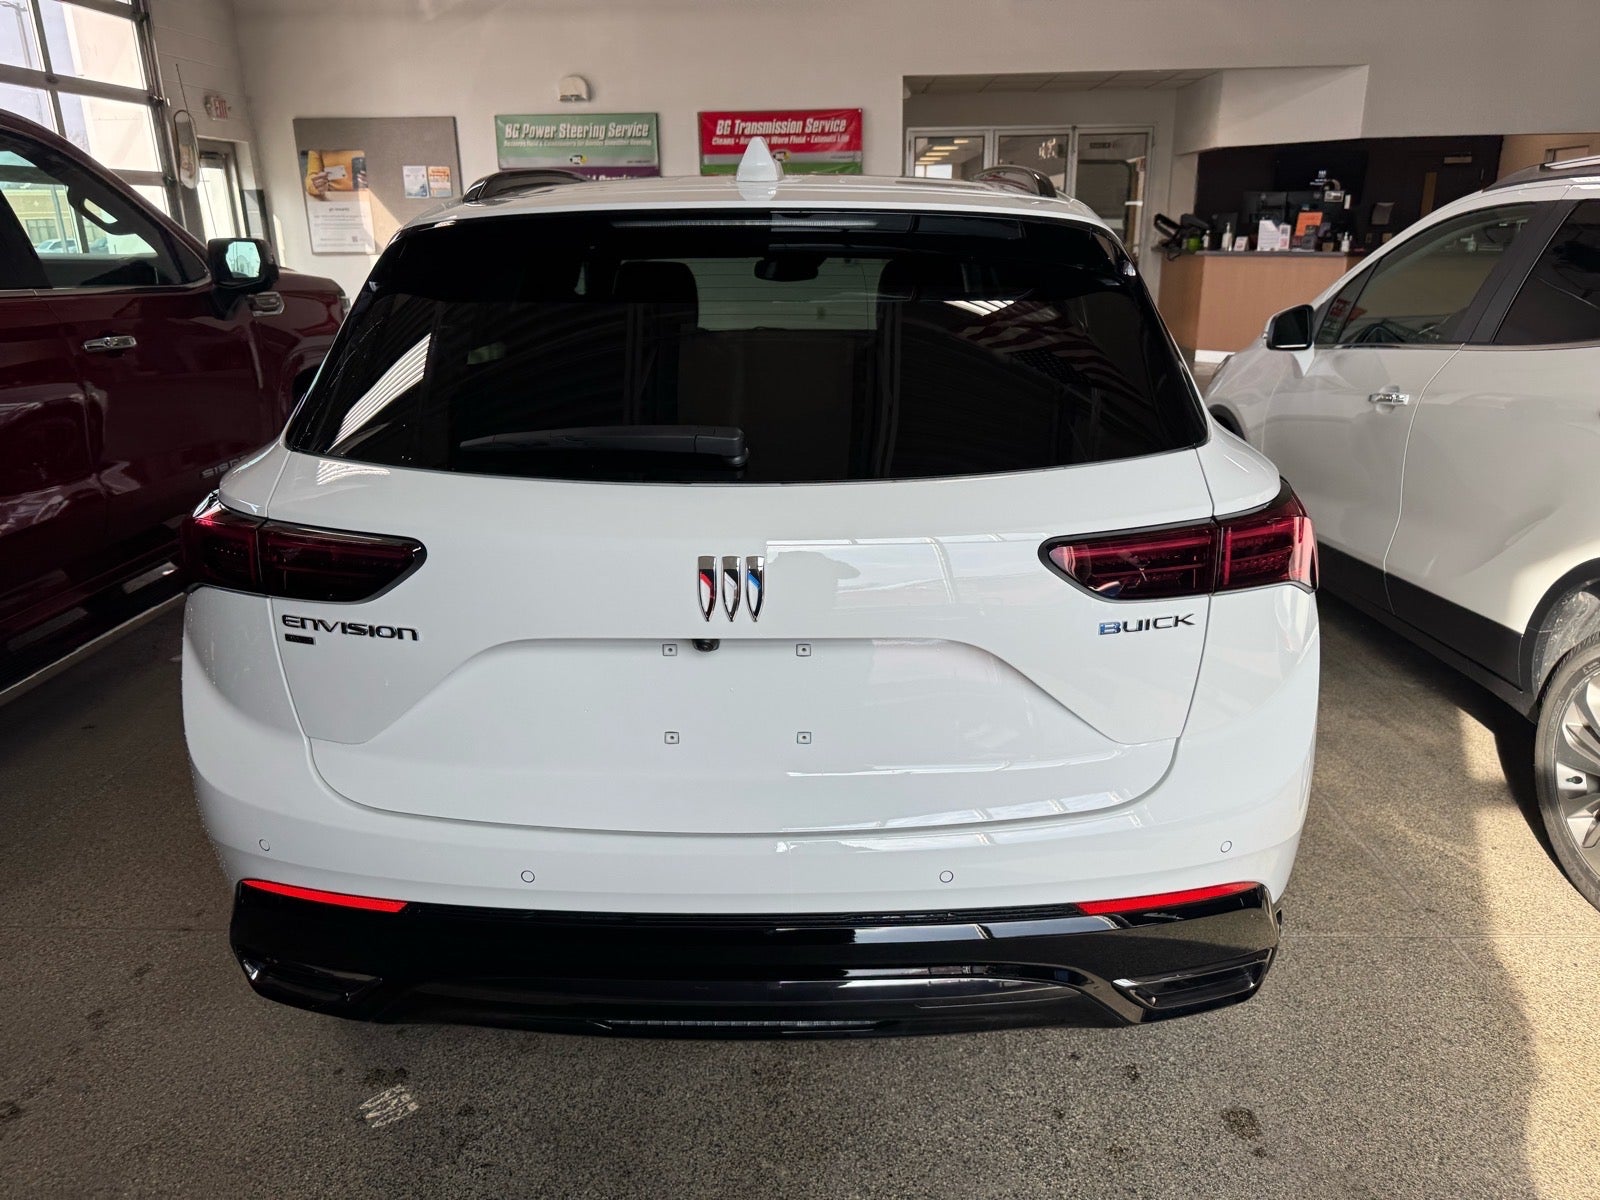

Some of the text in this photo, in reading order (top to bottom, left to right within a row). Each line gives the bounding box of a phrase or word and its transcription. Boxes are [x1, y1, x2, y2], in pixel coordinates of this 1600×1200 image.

[213, 99, 228, 120] EXIT
[504, 121, 649, 141] BG Power Steering Service
[716, 116, 847, 135] BG Transmission Service
[281, 614, 419, 641] ENVISION
[1098, 613, 1195, 635] BUICK
